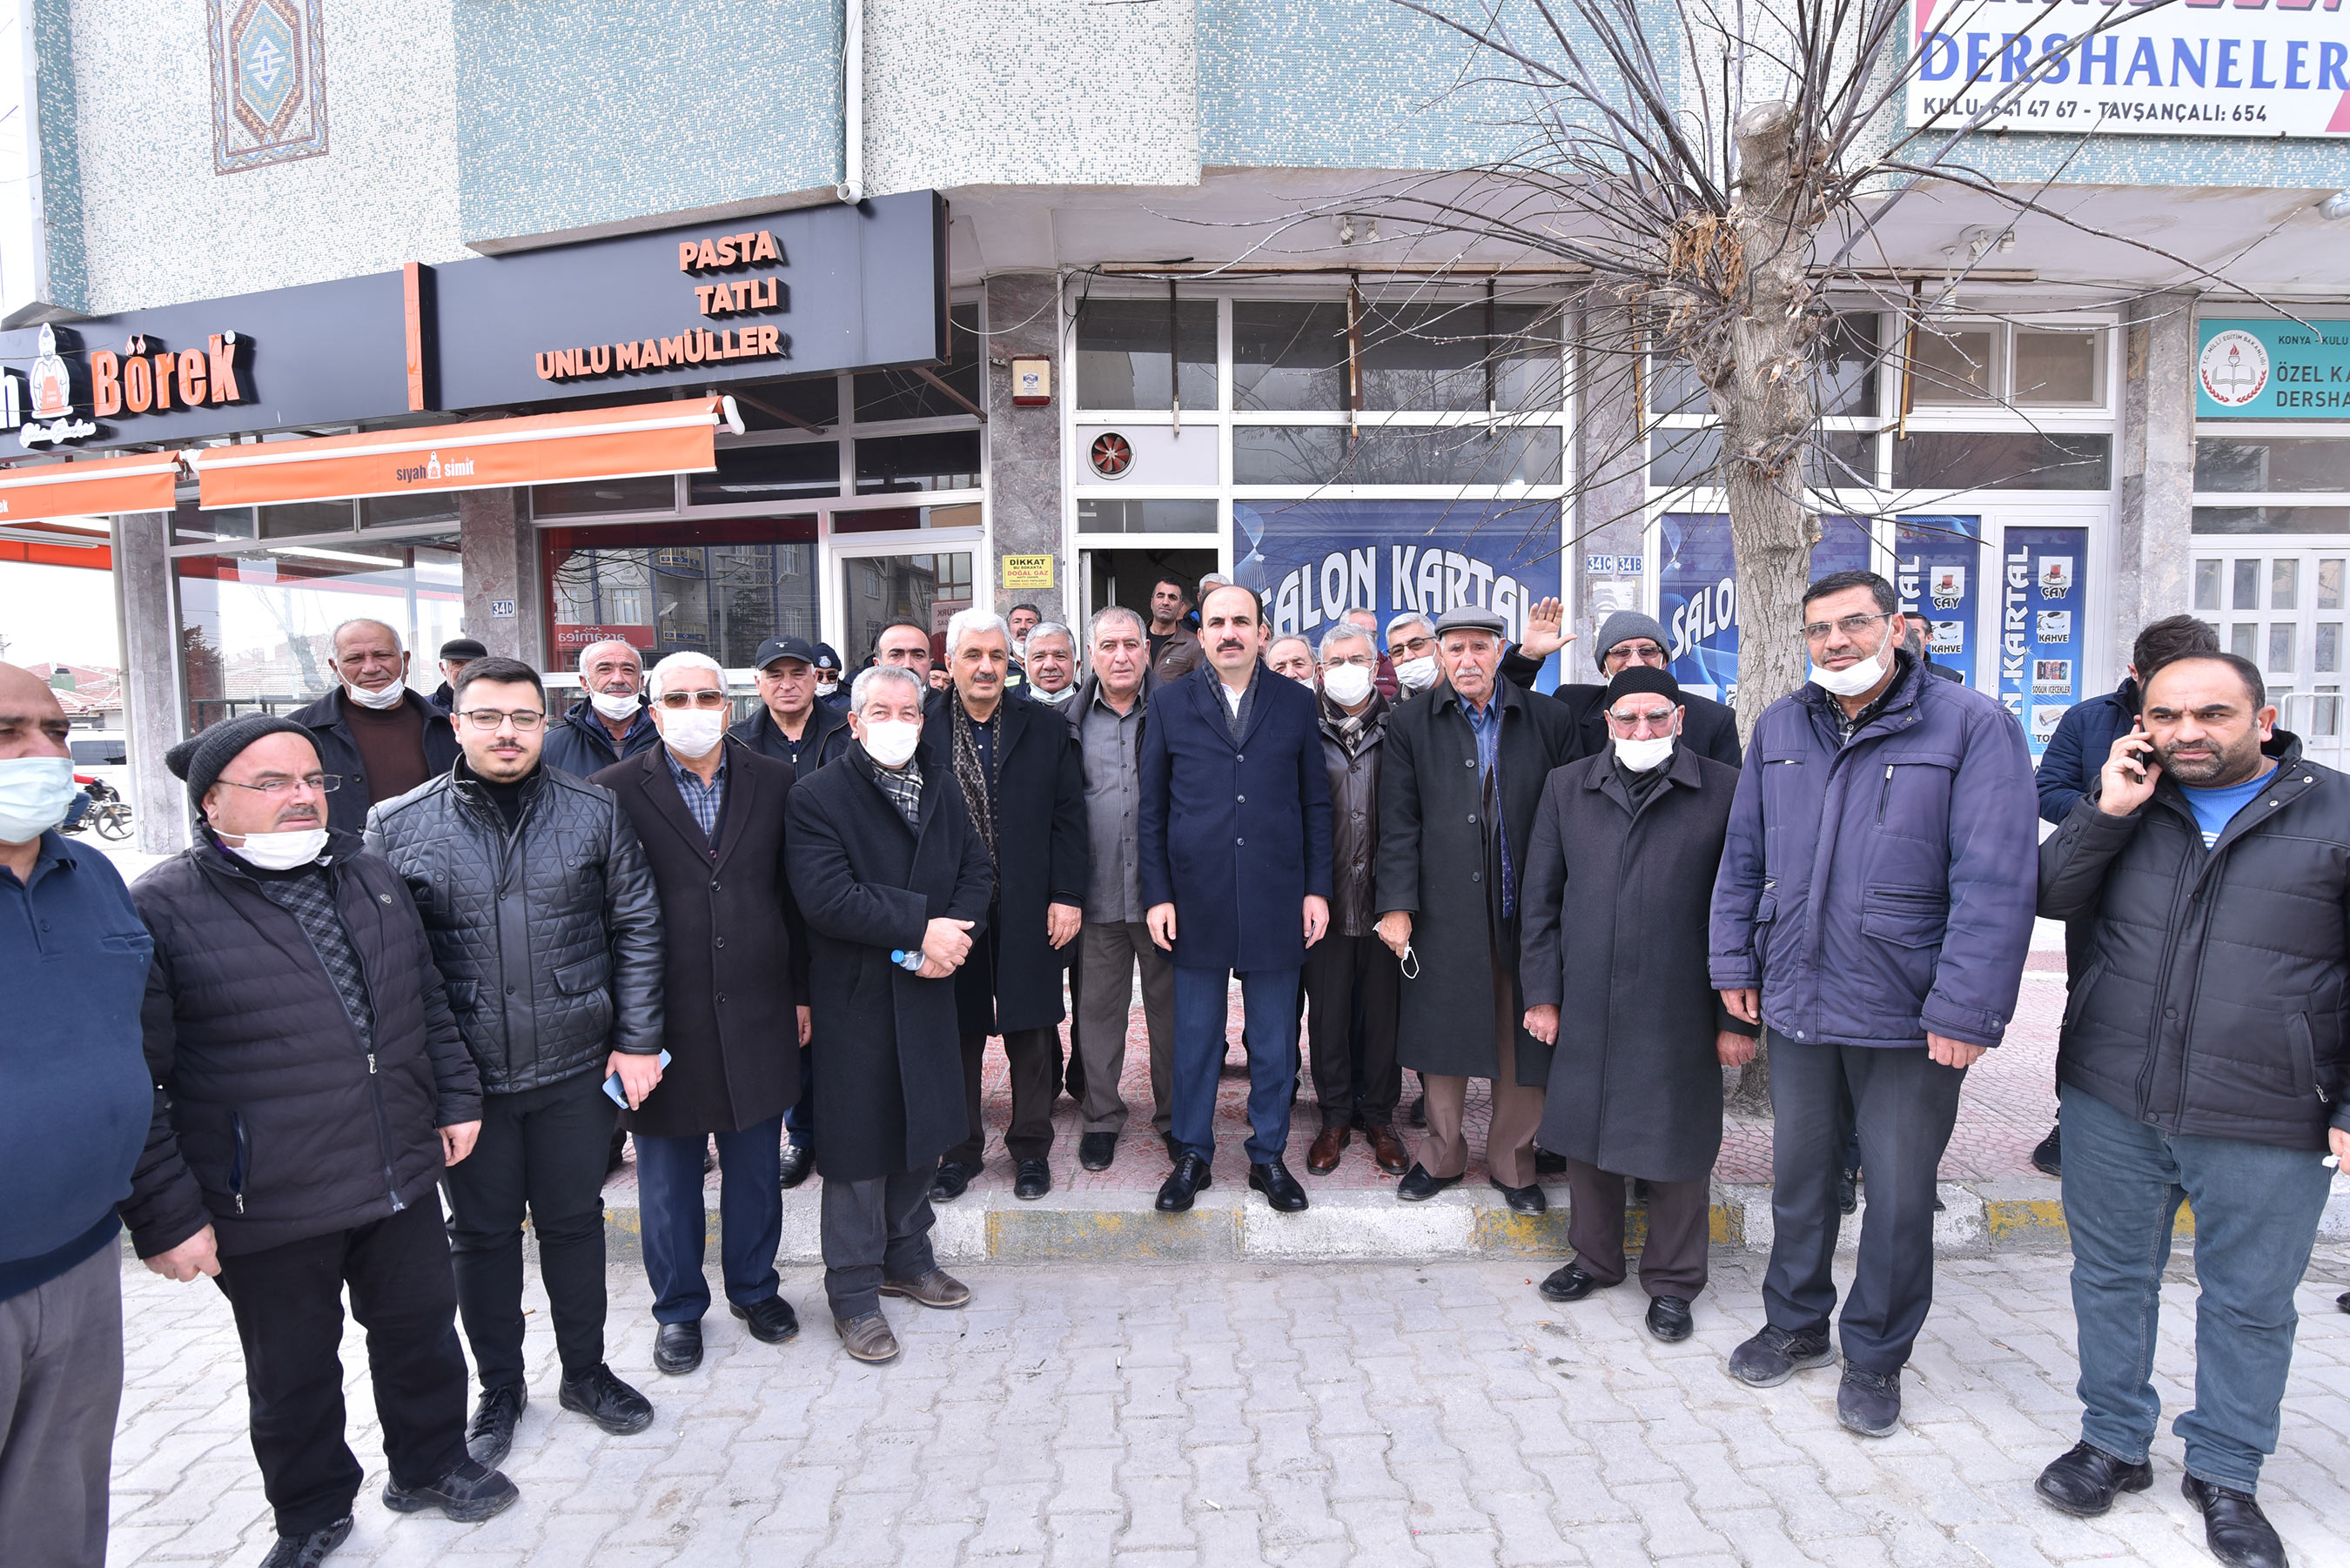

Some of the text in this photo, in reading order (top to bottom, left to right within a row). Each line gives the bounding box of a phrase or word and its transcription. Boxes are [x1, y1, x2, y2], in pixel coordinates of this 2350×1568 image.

[1919, 31, 2350, 90] DERSHANELER
[2028, 100, 2050, 117] 47
[2056, 101, 2078, 117] 67
[2098, 101, 2226, 123] TAVŞANÇALI:
[2232, 104, 2266, 122] 654
[679, 230, 777, 271] PASTA
[695, 276, 777, 315] TATLI
[535, 325, 780, 380] UNLU MAMÜLLER
[2279, 336, 2311, 345] KONYA
[91, 333, 239, 417] Börek
[2277, 361, 2324, 382] ÖZEL
[397, 456, 474, 483] siyah simit
[1934, 597, 1959, 609] ÇAY
[2003, 545, 2030, 679] KARTAL
[2042, 587, 2067, 599] ÇAY
[1671, 577, 1739, 663] SALO
